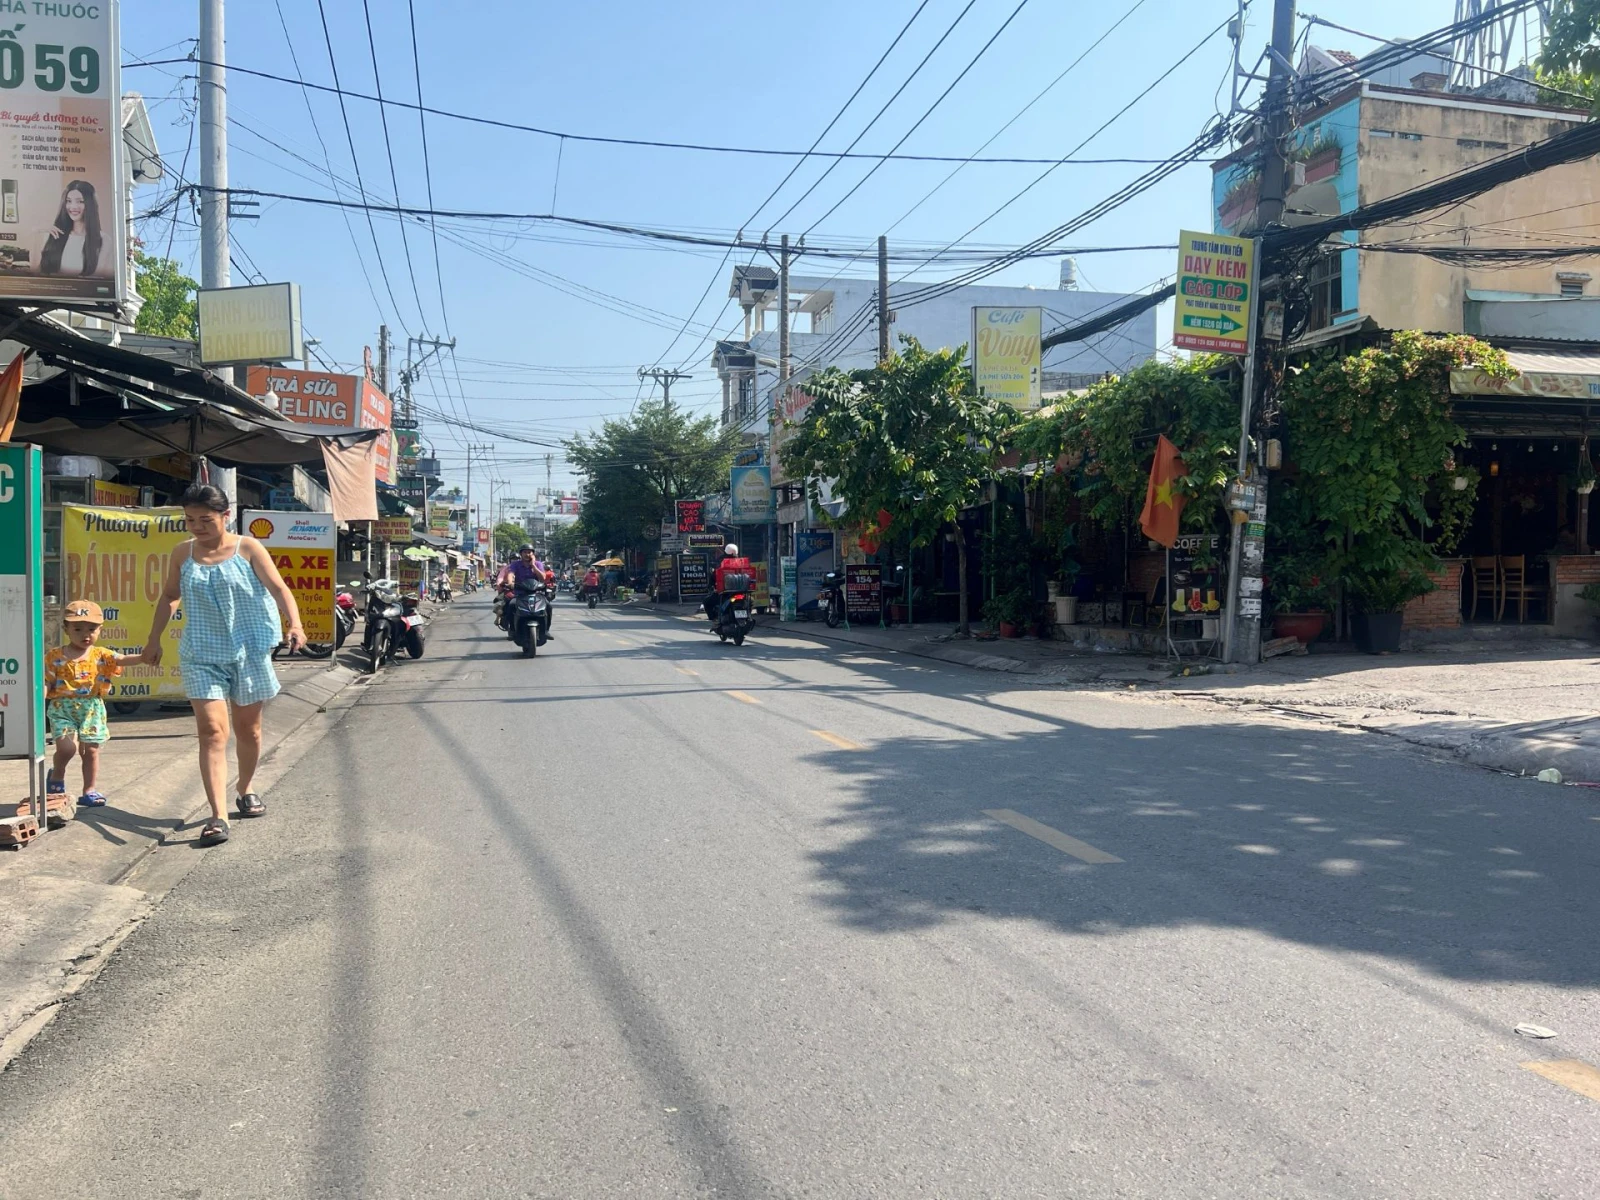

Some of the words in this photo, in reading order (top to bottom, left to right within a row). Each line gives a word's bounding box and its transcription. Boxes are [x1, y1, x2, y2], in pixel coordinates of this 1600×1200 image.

[34, 44, 100, 94] 59
[43, 112, 79, 126] dưỡng
[81, 115, 99, 125] tóc
[1185, 279, 1214, 297] CÁC
[1217, 282, 1243, 300] LỚP
[266, 375, 298, 394] TRÀ
[303, 378, 338, 397] SỮA
[253, 395, 347, 420] ELING
[288, 525, 330, 533] ADVANCE
[1173, 538, 1219, 550] COFFE
[300, 555, 329, 570] XE
[68, 542, 137, 602] BÁNH
[855, 575, 873, 583] 154
[283, 573, 331, 590] ÁNH
[302, 593, 313, 603] Tay
[313, 594, 323, 602] Ga
[307, 620, 319, 629] Cao
[120, 682, 150, 696] XOÀI
